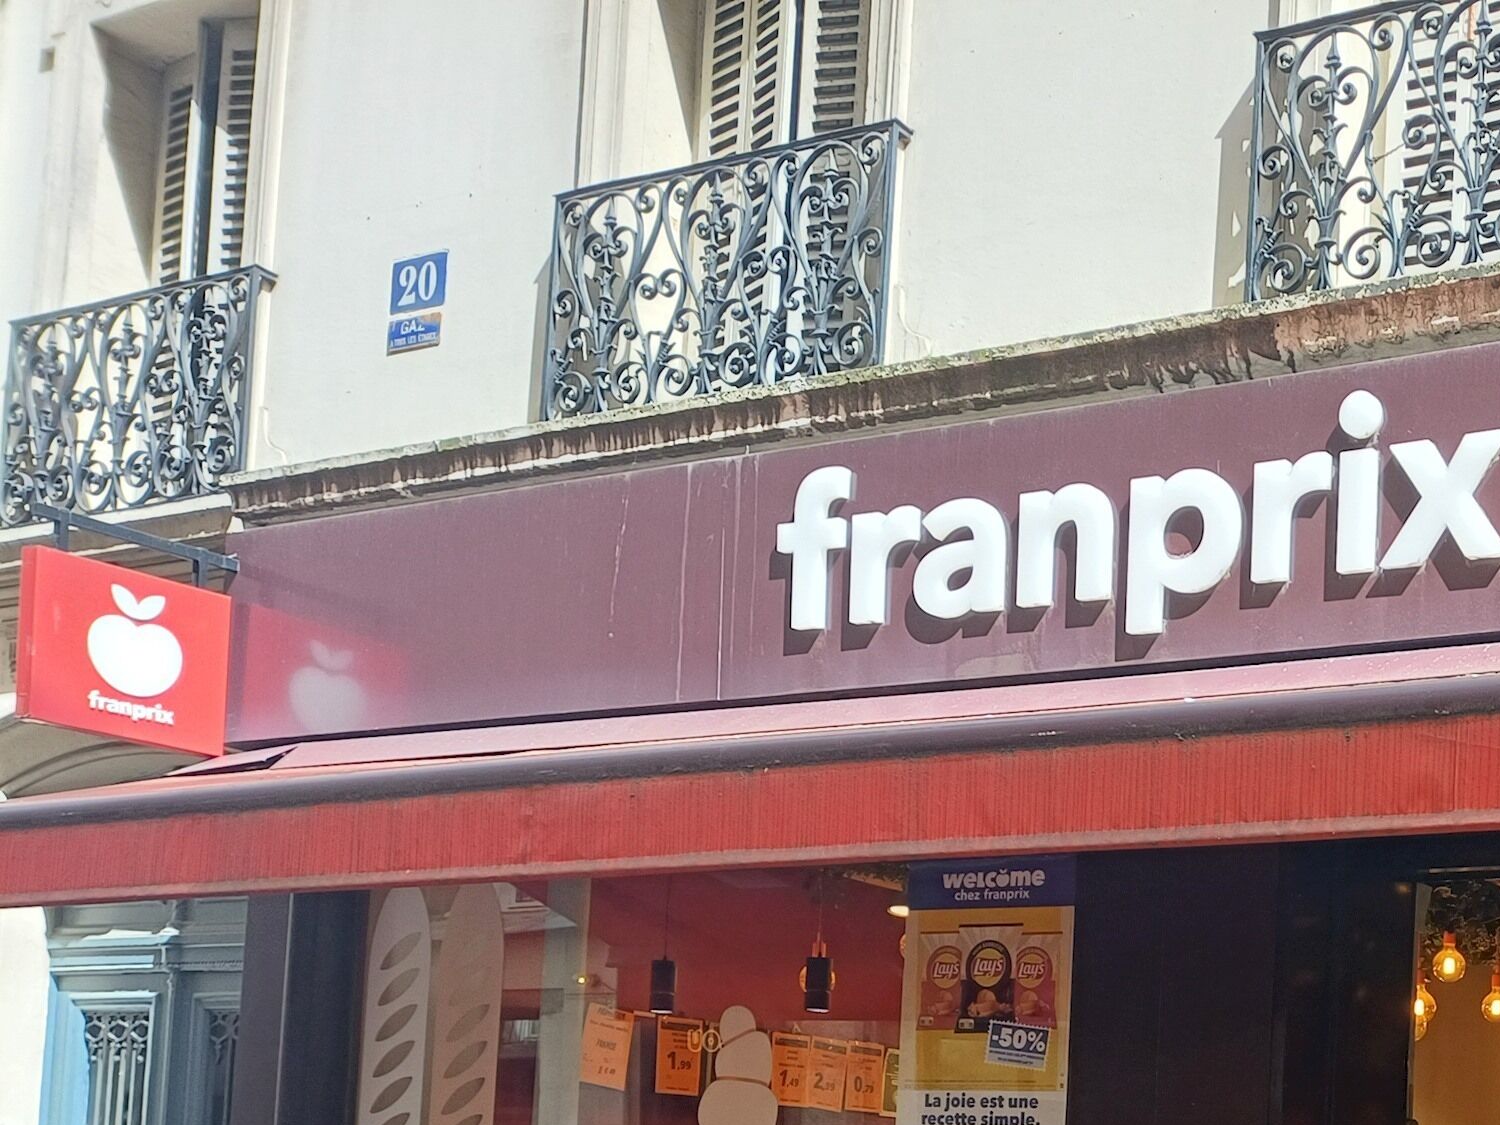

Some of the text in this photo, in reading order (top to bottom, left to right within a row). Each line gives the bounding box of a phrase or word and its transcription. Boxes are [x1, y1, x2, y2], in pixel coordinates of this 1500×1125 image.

[397, 260, 437, 306] 20
[86, 689, 175, 726] franprix
[943, 868, 1046, 889] welcome
[954, 887, 1030, 902] chez franprix
[973, 957, 1004, 977] Lay's
[991, 1027, 1046, 1052] -50%
[924, 1092, 1039, 1111] La joie est une
[921, 1113, 977, 1125] recette
